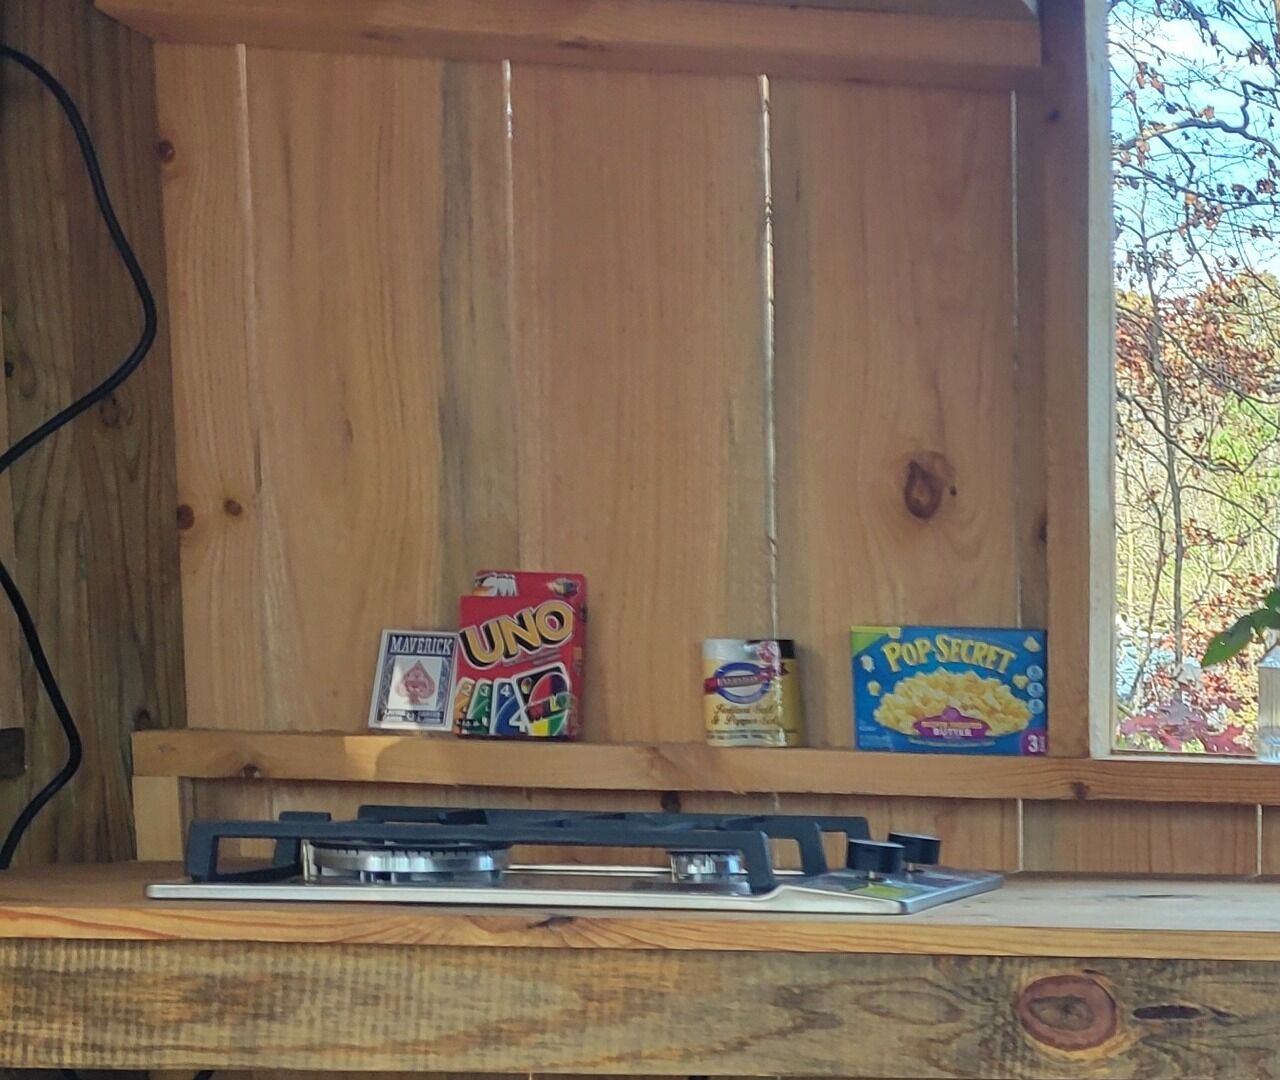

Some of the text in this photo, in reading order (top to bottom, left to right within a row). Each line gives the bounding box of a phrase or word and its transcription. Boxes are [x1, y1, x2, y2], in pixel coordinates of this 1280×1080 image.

[389, 635, 453, 655] MAVERICK
[459, 600, 575, 670] UNO
[883, 633, 1018, 675] POP SECRET
[933, 727, 973, 738] BUTTER
[1027, 734, 1039, 753] 3
